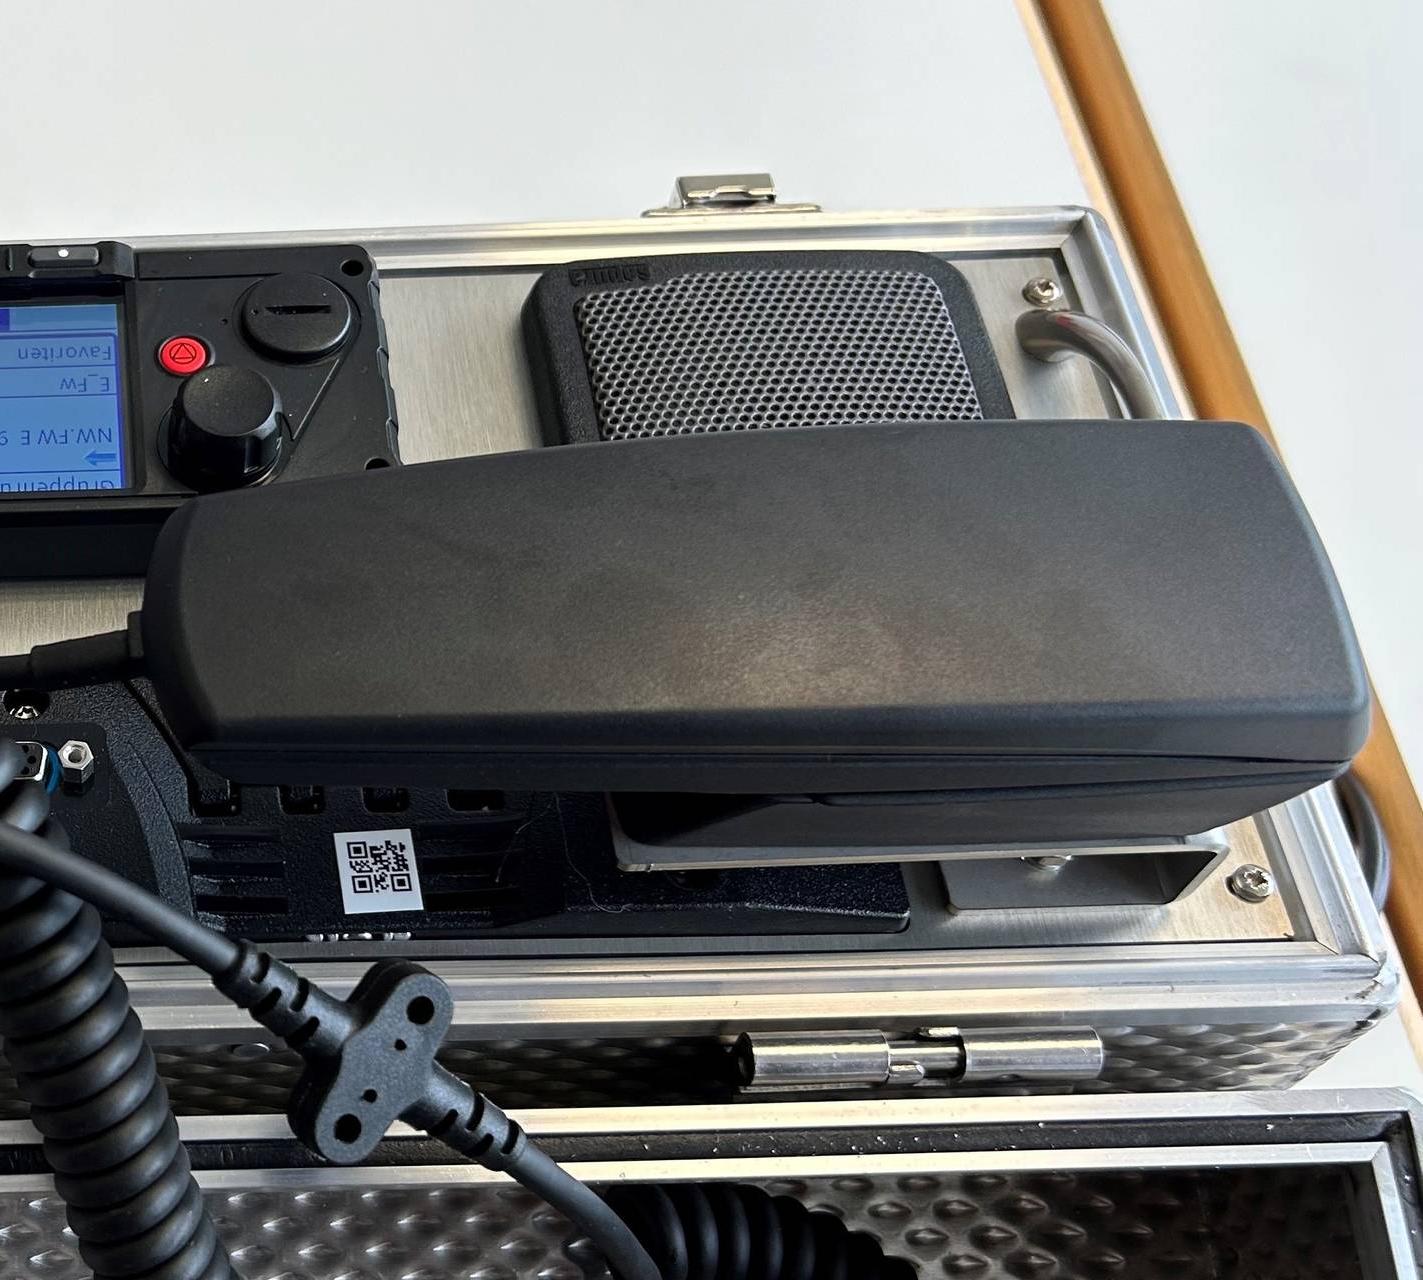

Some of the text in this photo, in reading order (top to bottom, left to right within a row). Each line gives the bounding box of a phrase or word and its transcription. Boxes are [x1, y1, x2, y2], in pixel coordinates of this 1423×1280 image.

[17, 346, 113, 363] Favoriten
[60, 373, 111, 393] E_Fw
[20, 430, 31, 445] E
[37, 428, 113, 445] NW.FW
